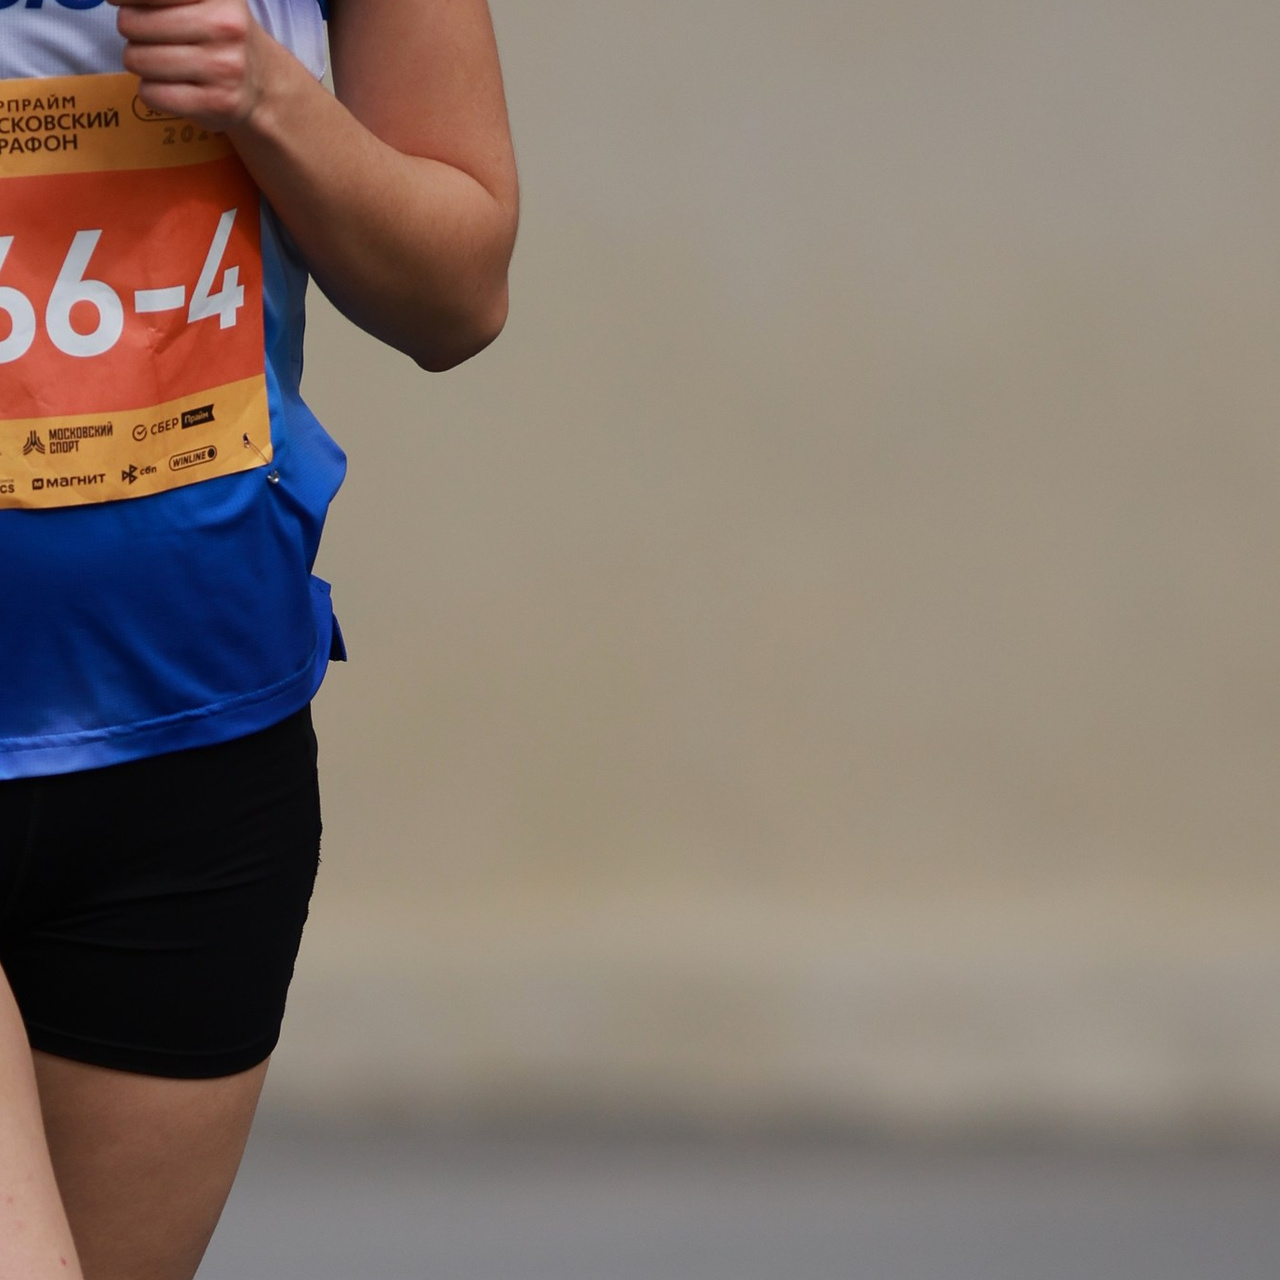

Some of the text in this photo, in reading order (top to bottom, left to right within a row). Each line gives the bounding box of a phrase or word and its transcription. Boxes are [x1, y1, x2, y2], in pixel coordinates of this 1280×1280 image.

[49, 421, 113, 441] МОСКОВСКИЙ
[150, 417, 179, 436] СБЕР
[49, 439, 80, 455] СПОРТ
[172, 449, 208, 469] WINLINE
